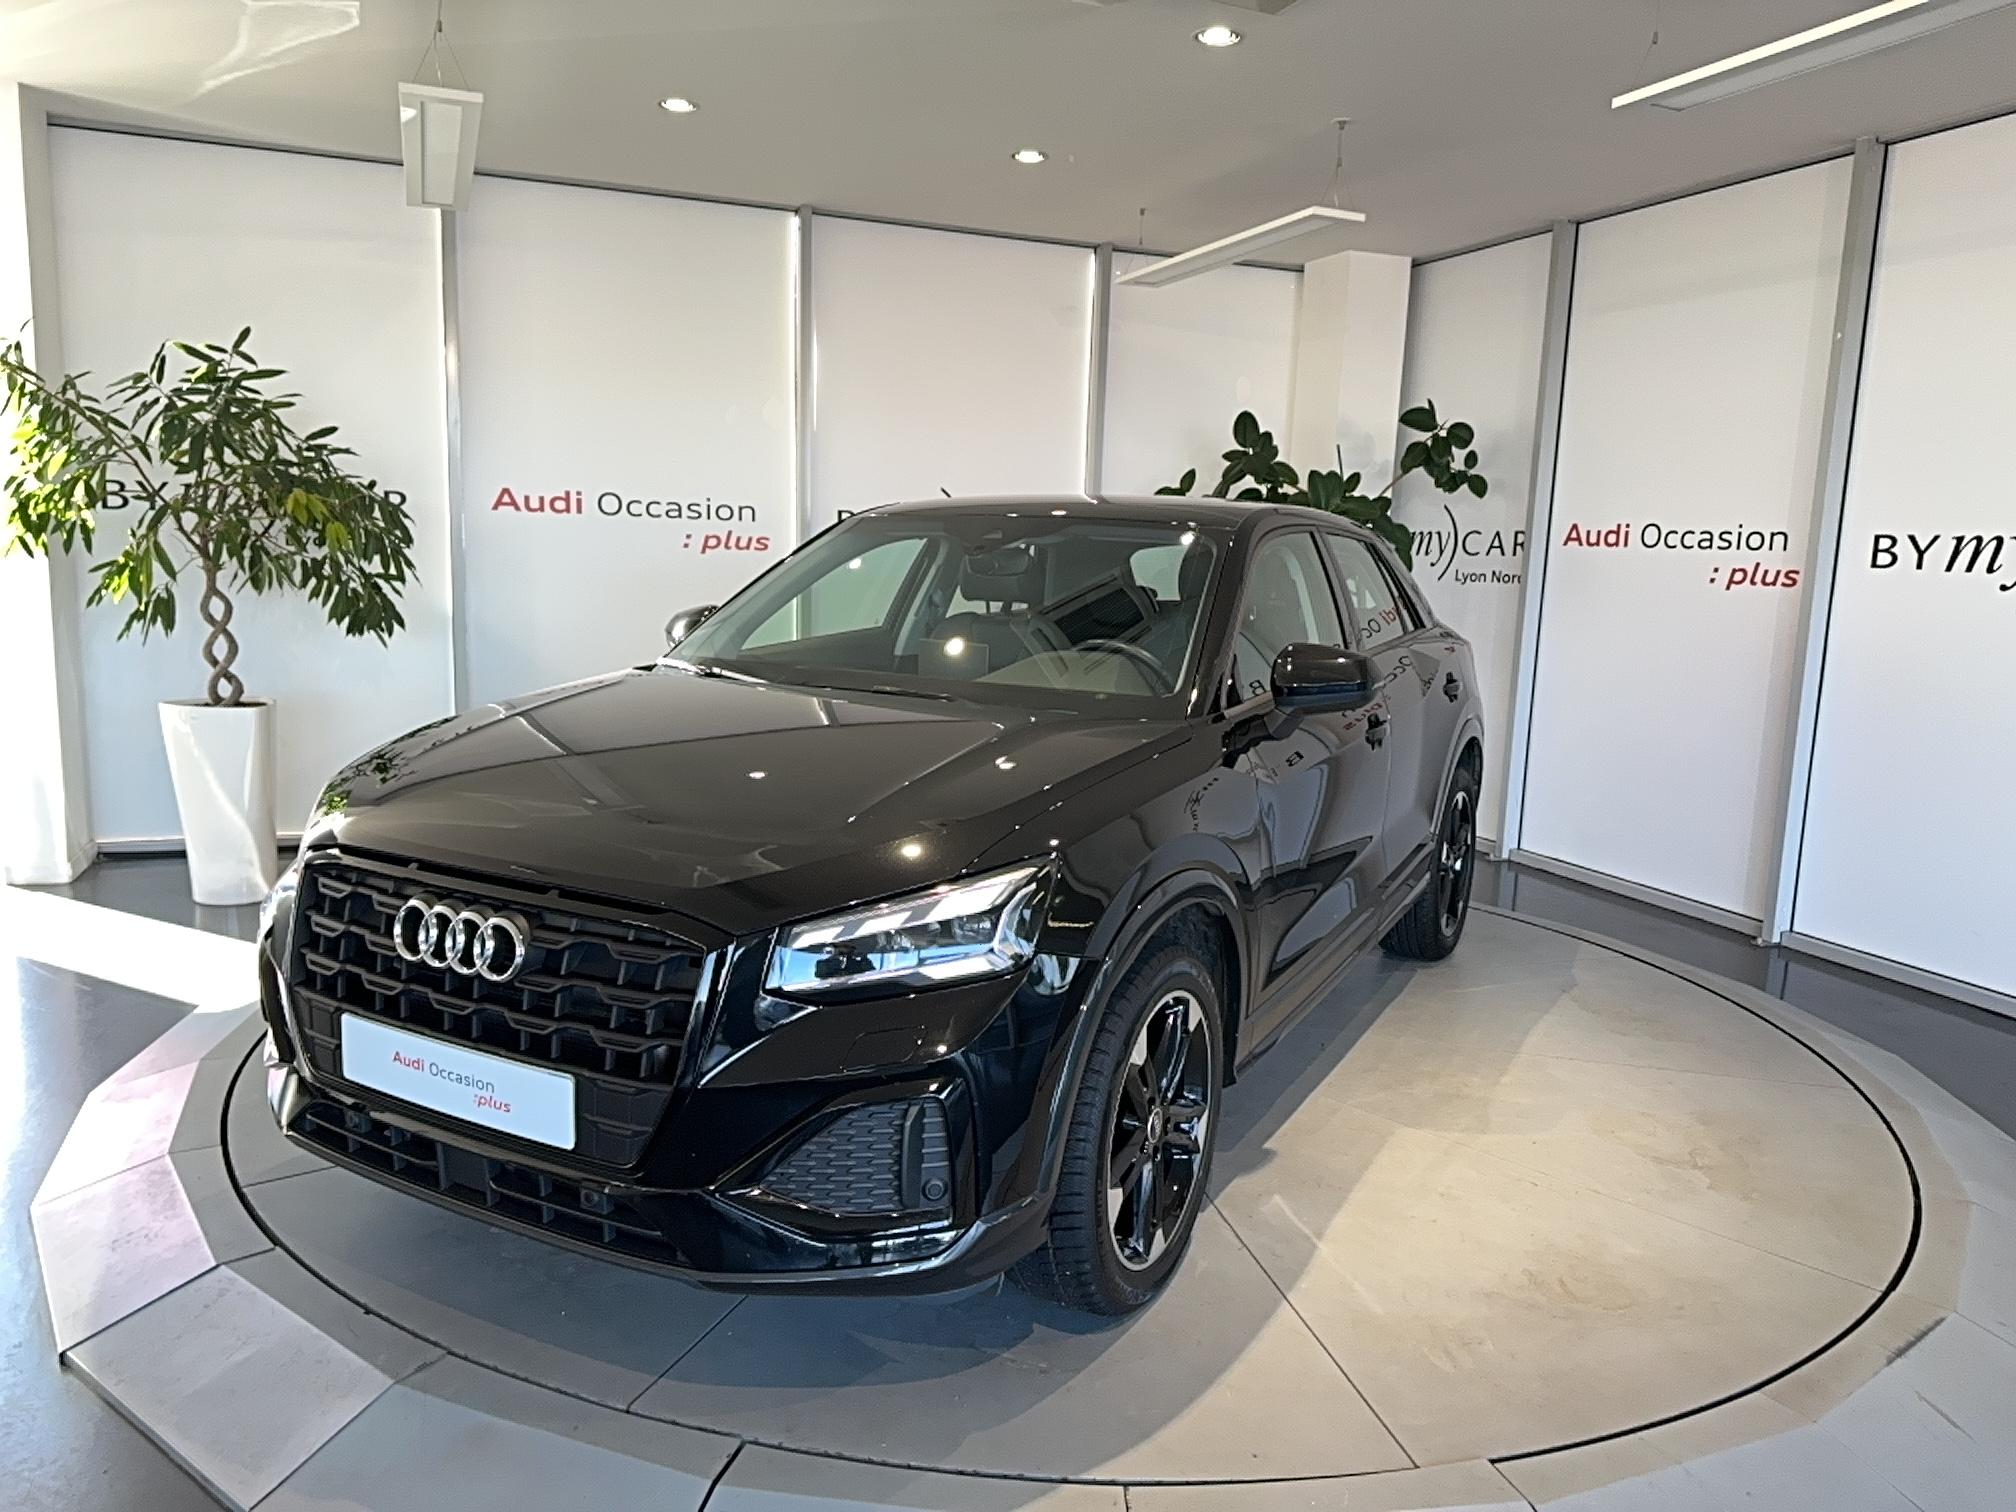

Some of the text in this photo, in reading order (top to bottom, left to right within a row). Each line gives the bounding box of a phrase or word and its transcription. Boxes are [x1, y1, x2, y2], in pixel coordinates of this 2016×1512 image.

[491, 487, 756, 522] Audi Occasion
[1563, 523, 1789, 551] Audi Occasion
[1455, 569, 1487, 585] Lyon
[392, 1050, 495, 1093] Audi Occasion
